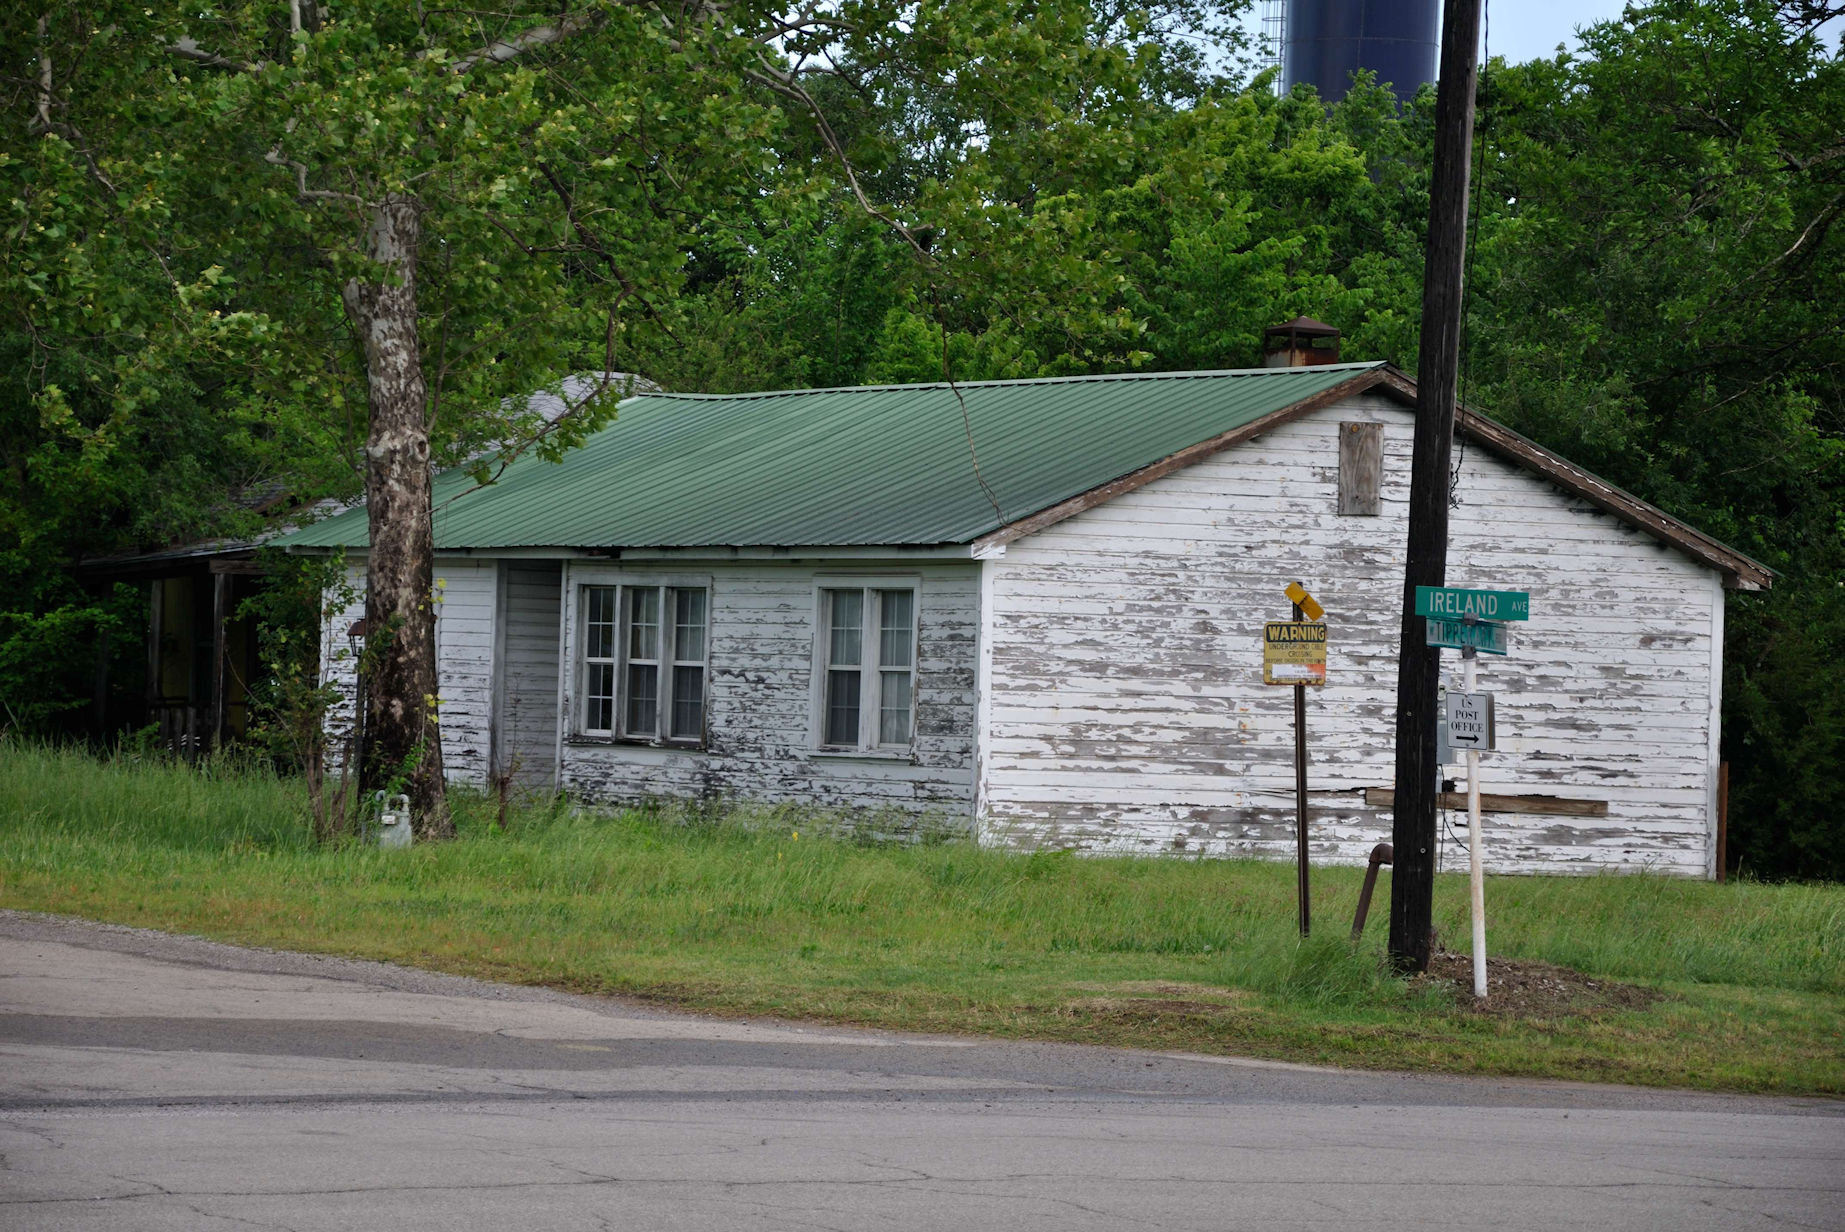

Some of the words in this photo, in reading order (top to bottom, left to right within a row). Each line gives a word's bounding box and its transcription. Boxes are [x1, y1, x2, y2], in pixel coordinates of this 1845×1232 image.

[1429, 591, 1498, 615] IRELAND
[1511, 601, 1528, 612] AVE
[1268, 625, 1325, 641] WARNING
[1461, 698, 1473, 709] US
[1455, 709, 1479, 721] POST
[1450, 720, 1484, 733] OFFICE
